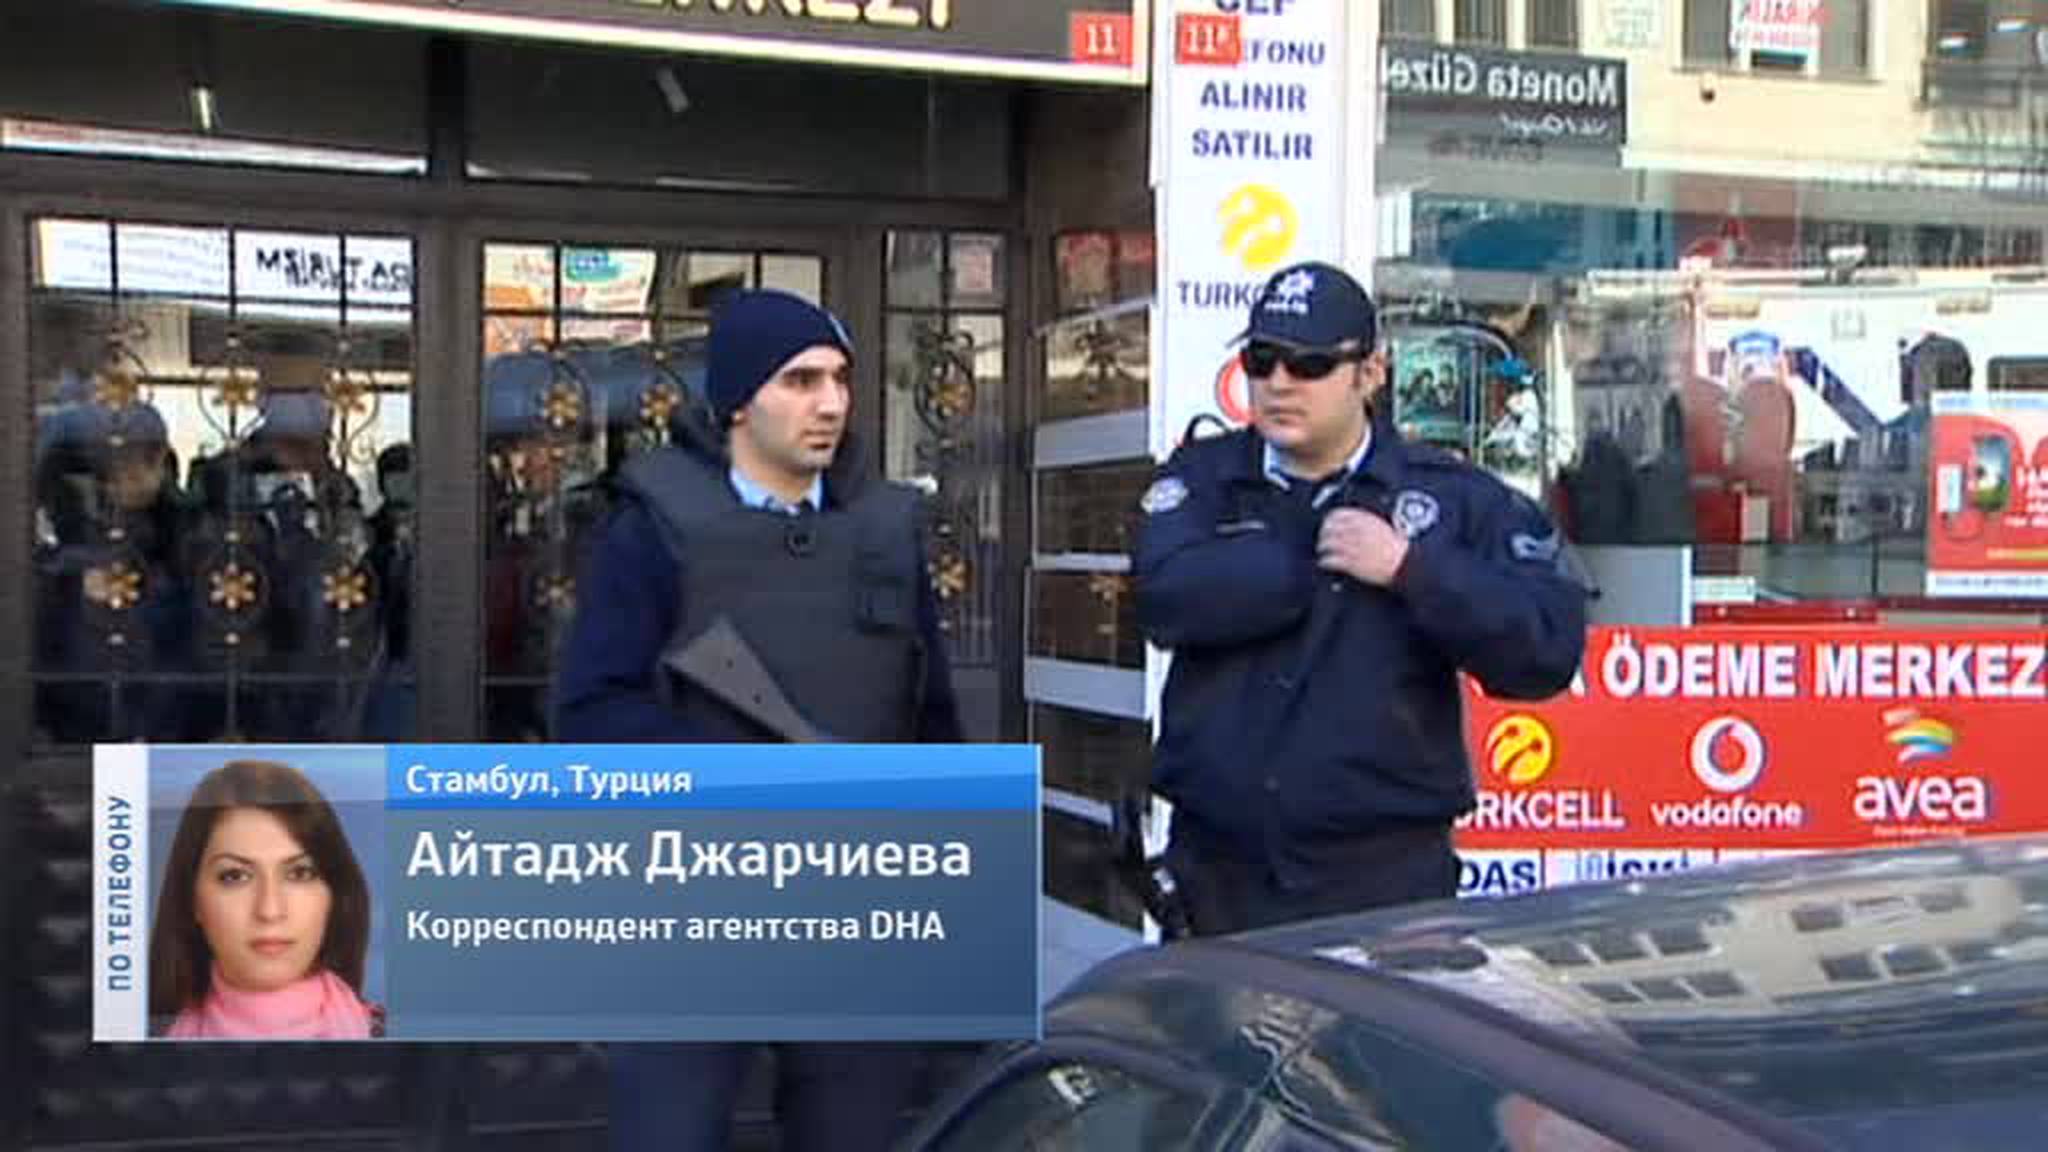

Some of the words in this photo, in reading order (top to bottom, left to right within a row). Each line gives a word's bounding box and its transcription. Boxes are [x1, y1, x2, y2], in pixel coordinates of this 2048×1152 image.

[1086, 23, 1119, 55] 11
[1200, 80, 1307, 112] ALINIR
[1191, 130, 1313, 160] SATILIR
[1602, 631, 1797, 698] ÖDEME
[1650, 795, 1803, 829] vodafone
[1854, 775, 1987, 822] avea
